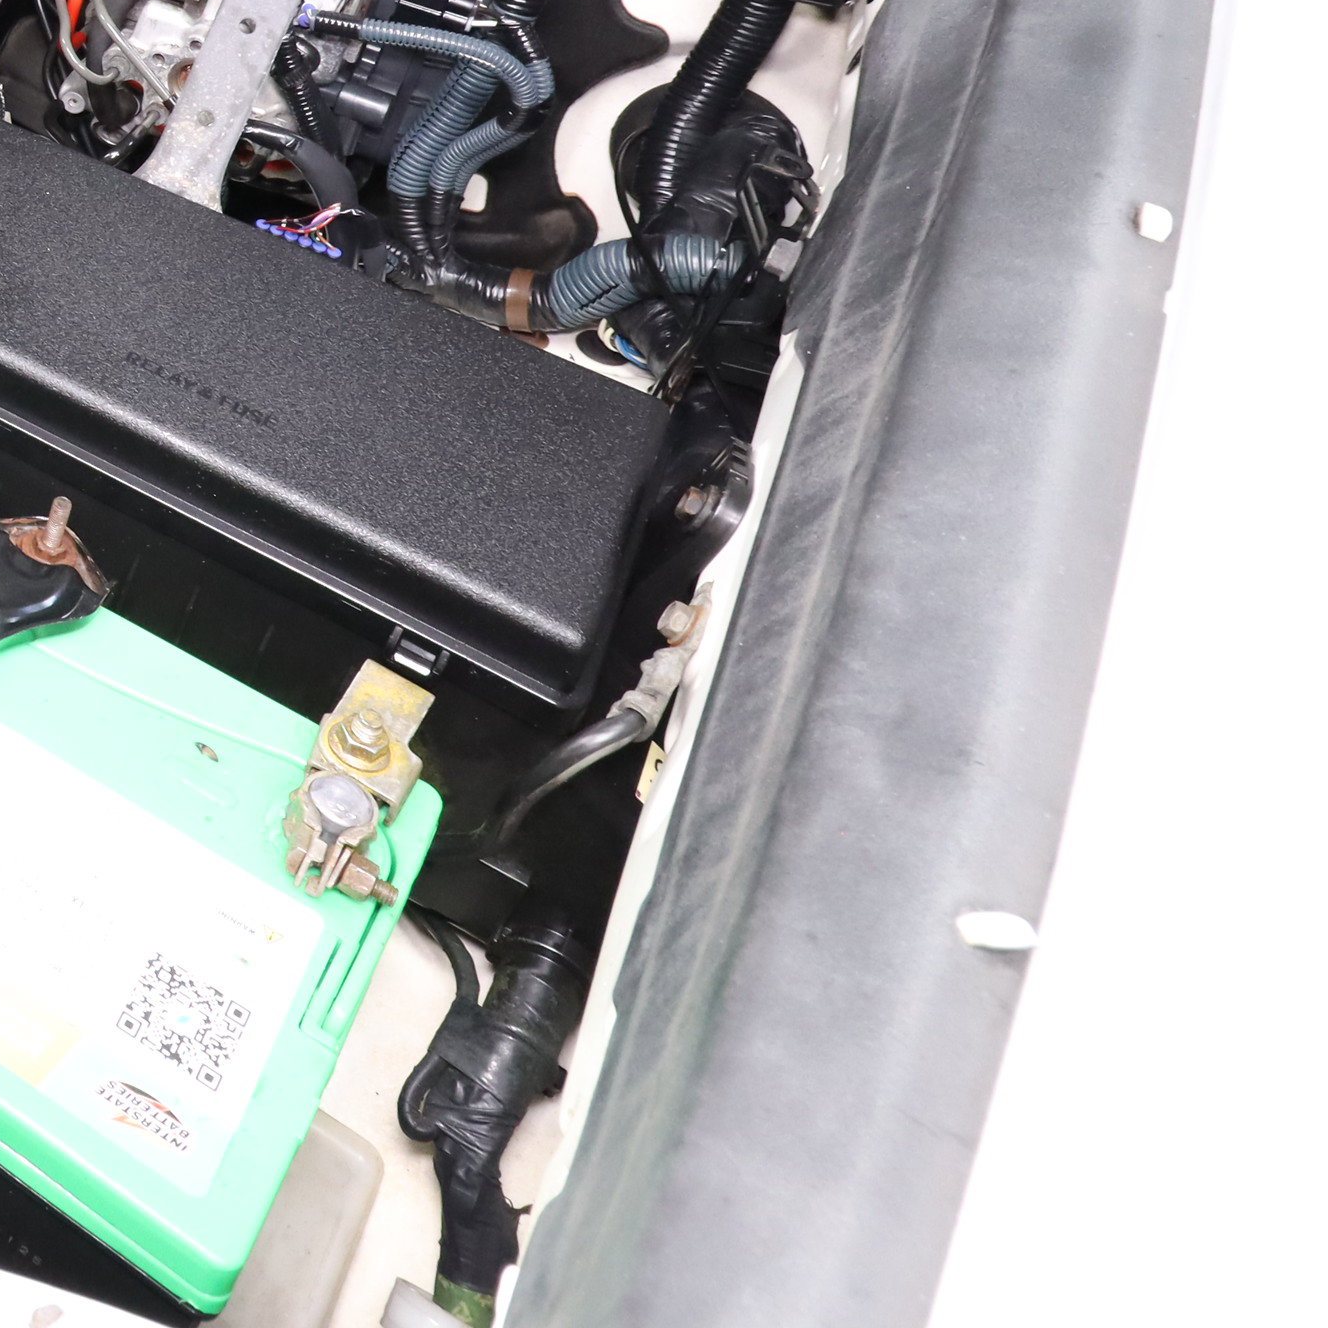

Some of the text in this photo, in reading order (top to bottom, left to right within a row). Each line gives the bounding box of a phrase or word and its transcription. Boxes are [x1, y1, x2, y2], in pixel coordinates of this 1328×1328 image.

[124, 351, 198, 391] RELAY
[217, 394, 280, 432] FUSE
[95, 1086, 188, 1151] INTERSTATE
[107, 1080, 190, 1139] BATTERIES
